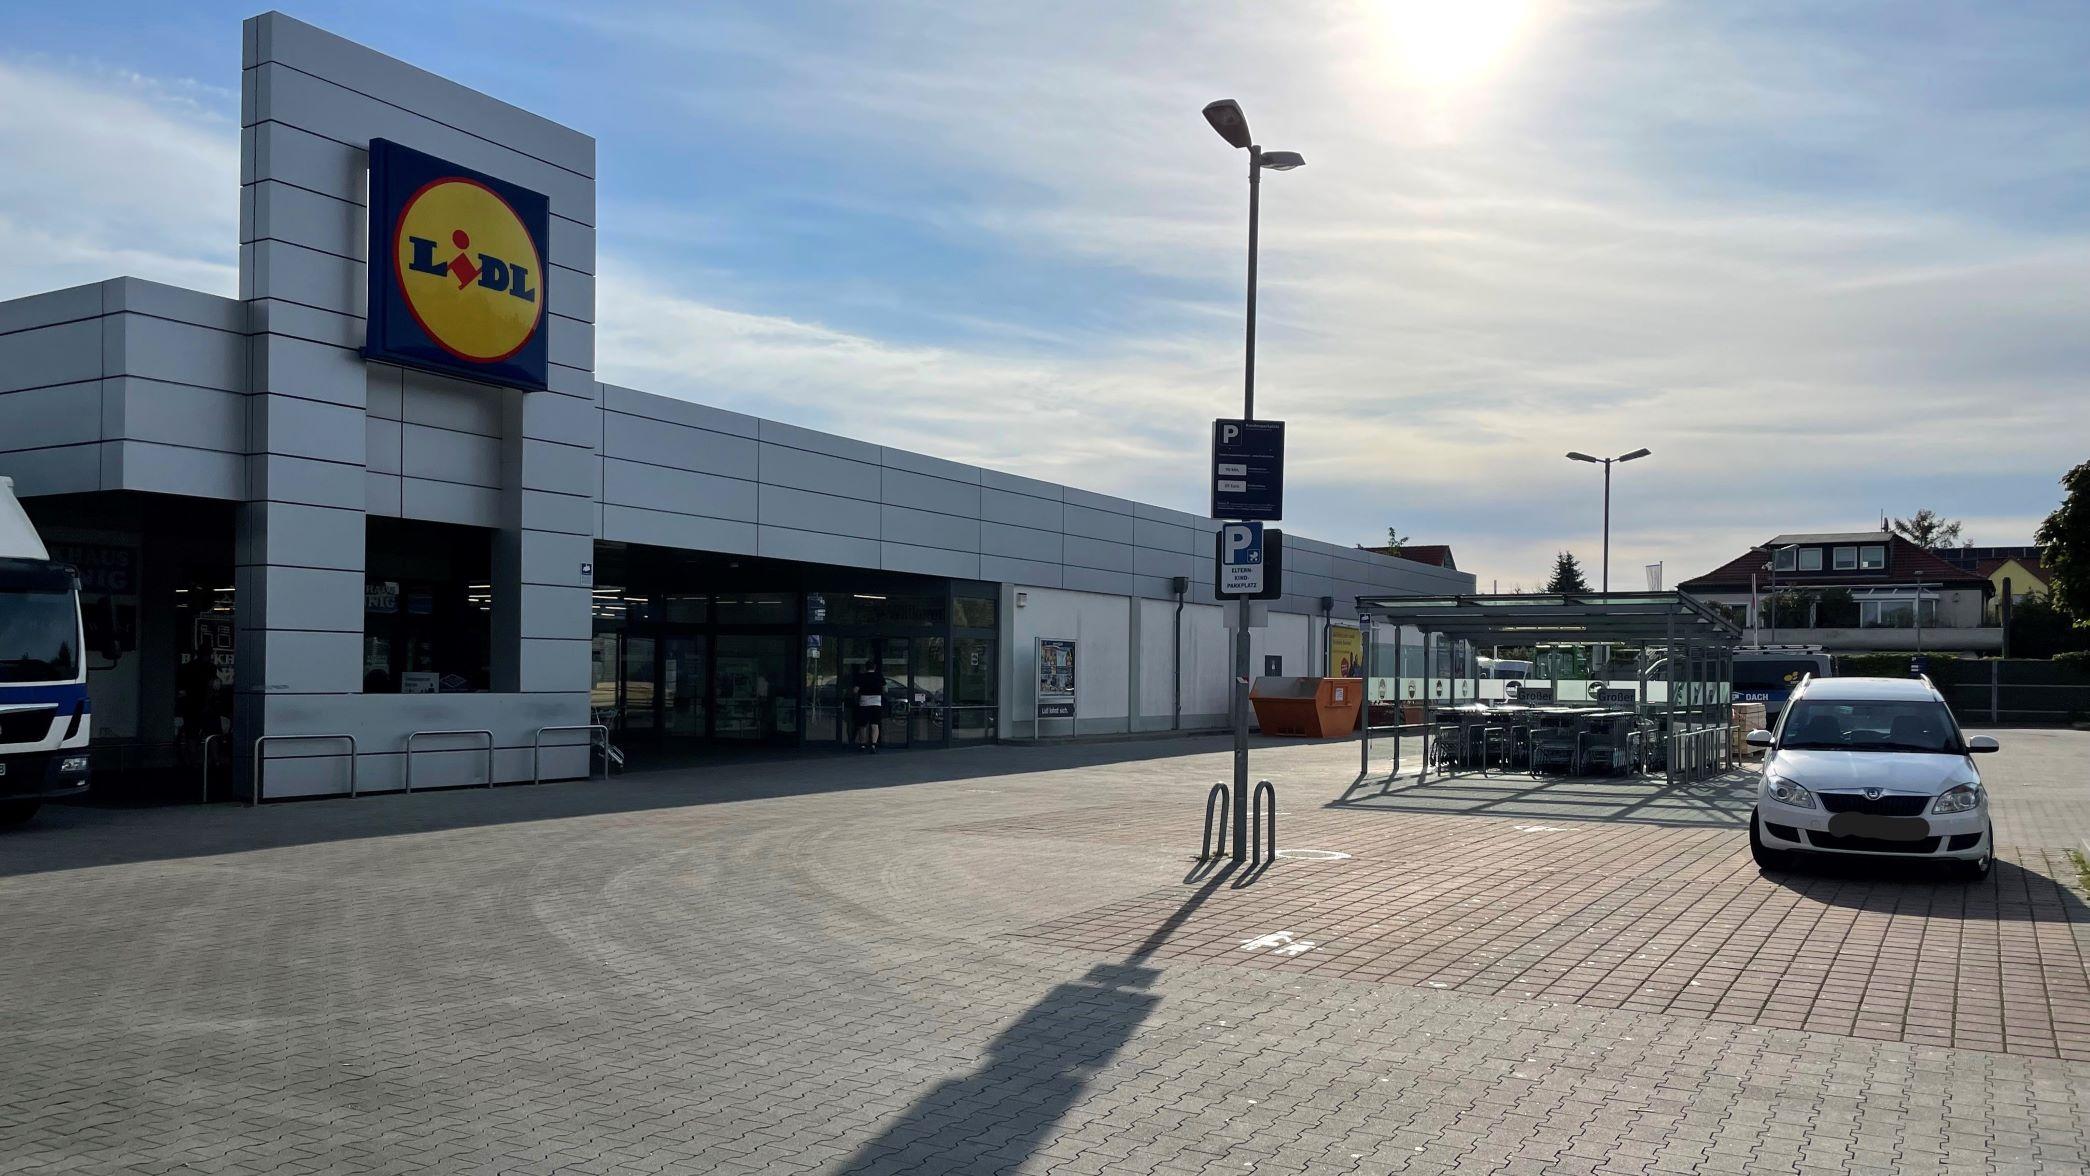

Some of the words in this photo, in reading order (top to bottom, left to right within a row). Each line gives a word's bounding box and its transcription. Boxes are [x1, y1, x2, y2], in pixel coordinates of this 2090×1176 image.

[1223, 424, 1239, 444] P
[1225, 526, 1253, 564] P
[1745, 693, 1769, 701] DACH
